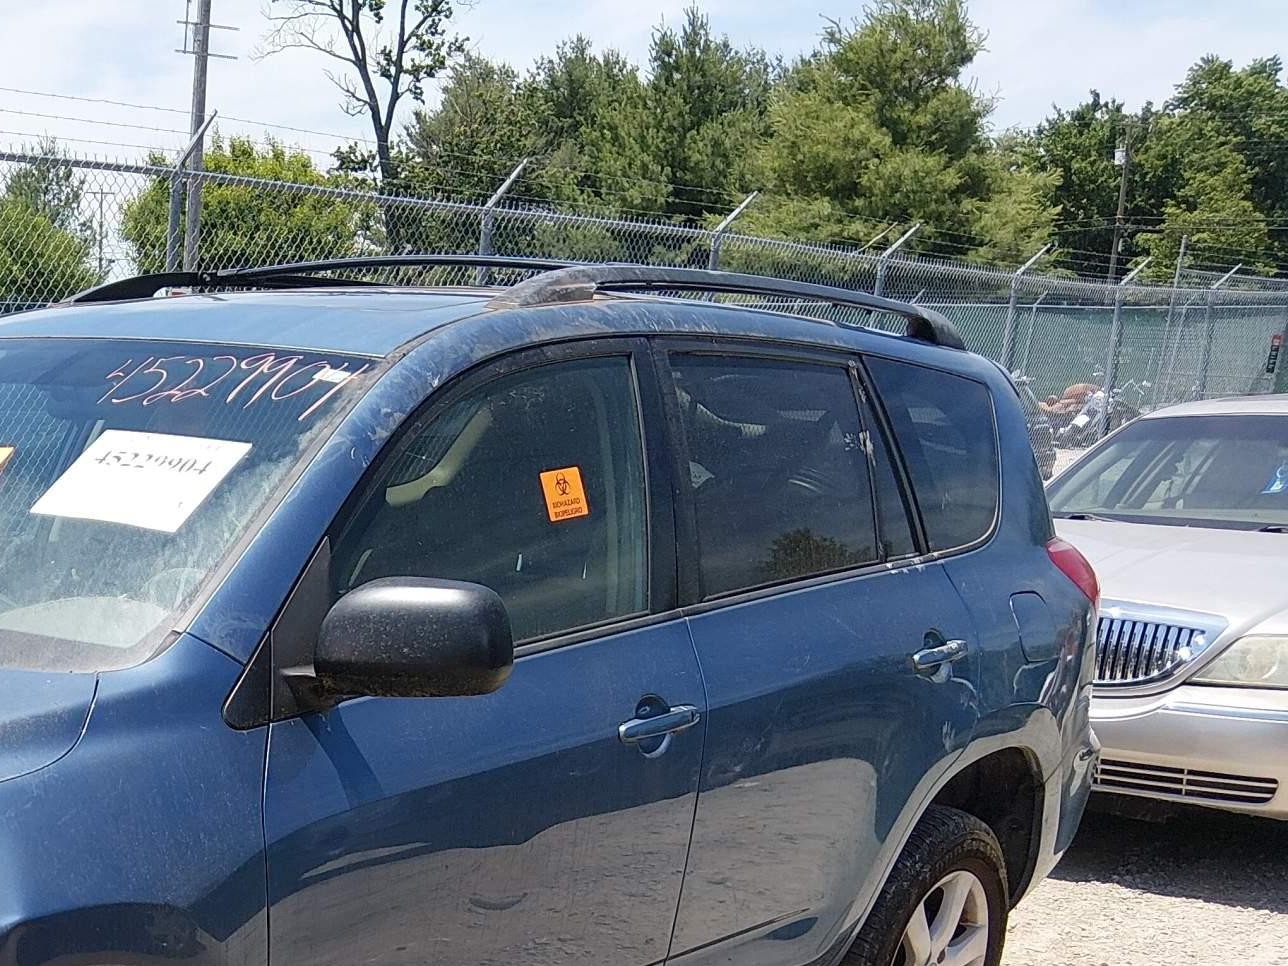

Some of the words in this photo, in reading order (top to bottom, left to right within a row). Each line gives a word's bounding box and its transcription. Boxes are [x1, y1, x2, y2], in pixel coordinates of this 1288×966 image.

[96, 353, 369, 421] 45229904
[95, 450, 212, 475] 45229904
[552, 497, 581, 509] BIOHAZARD
